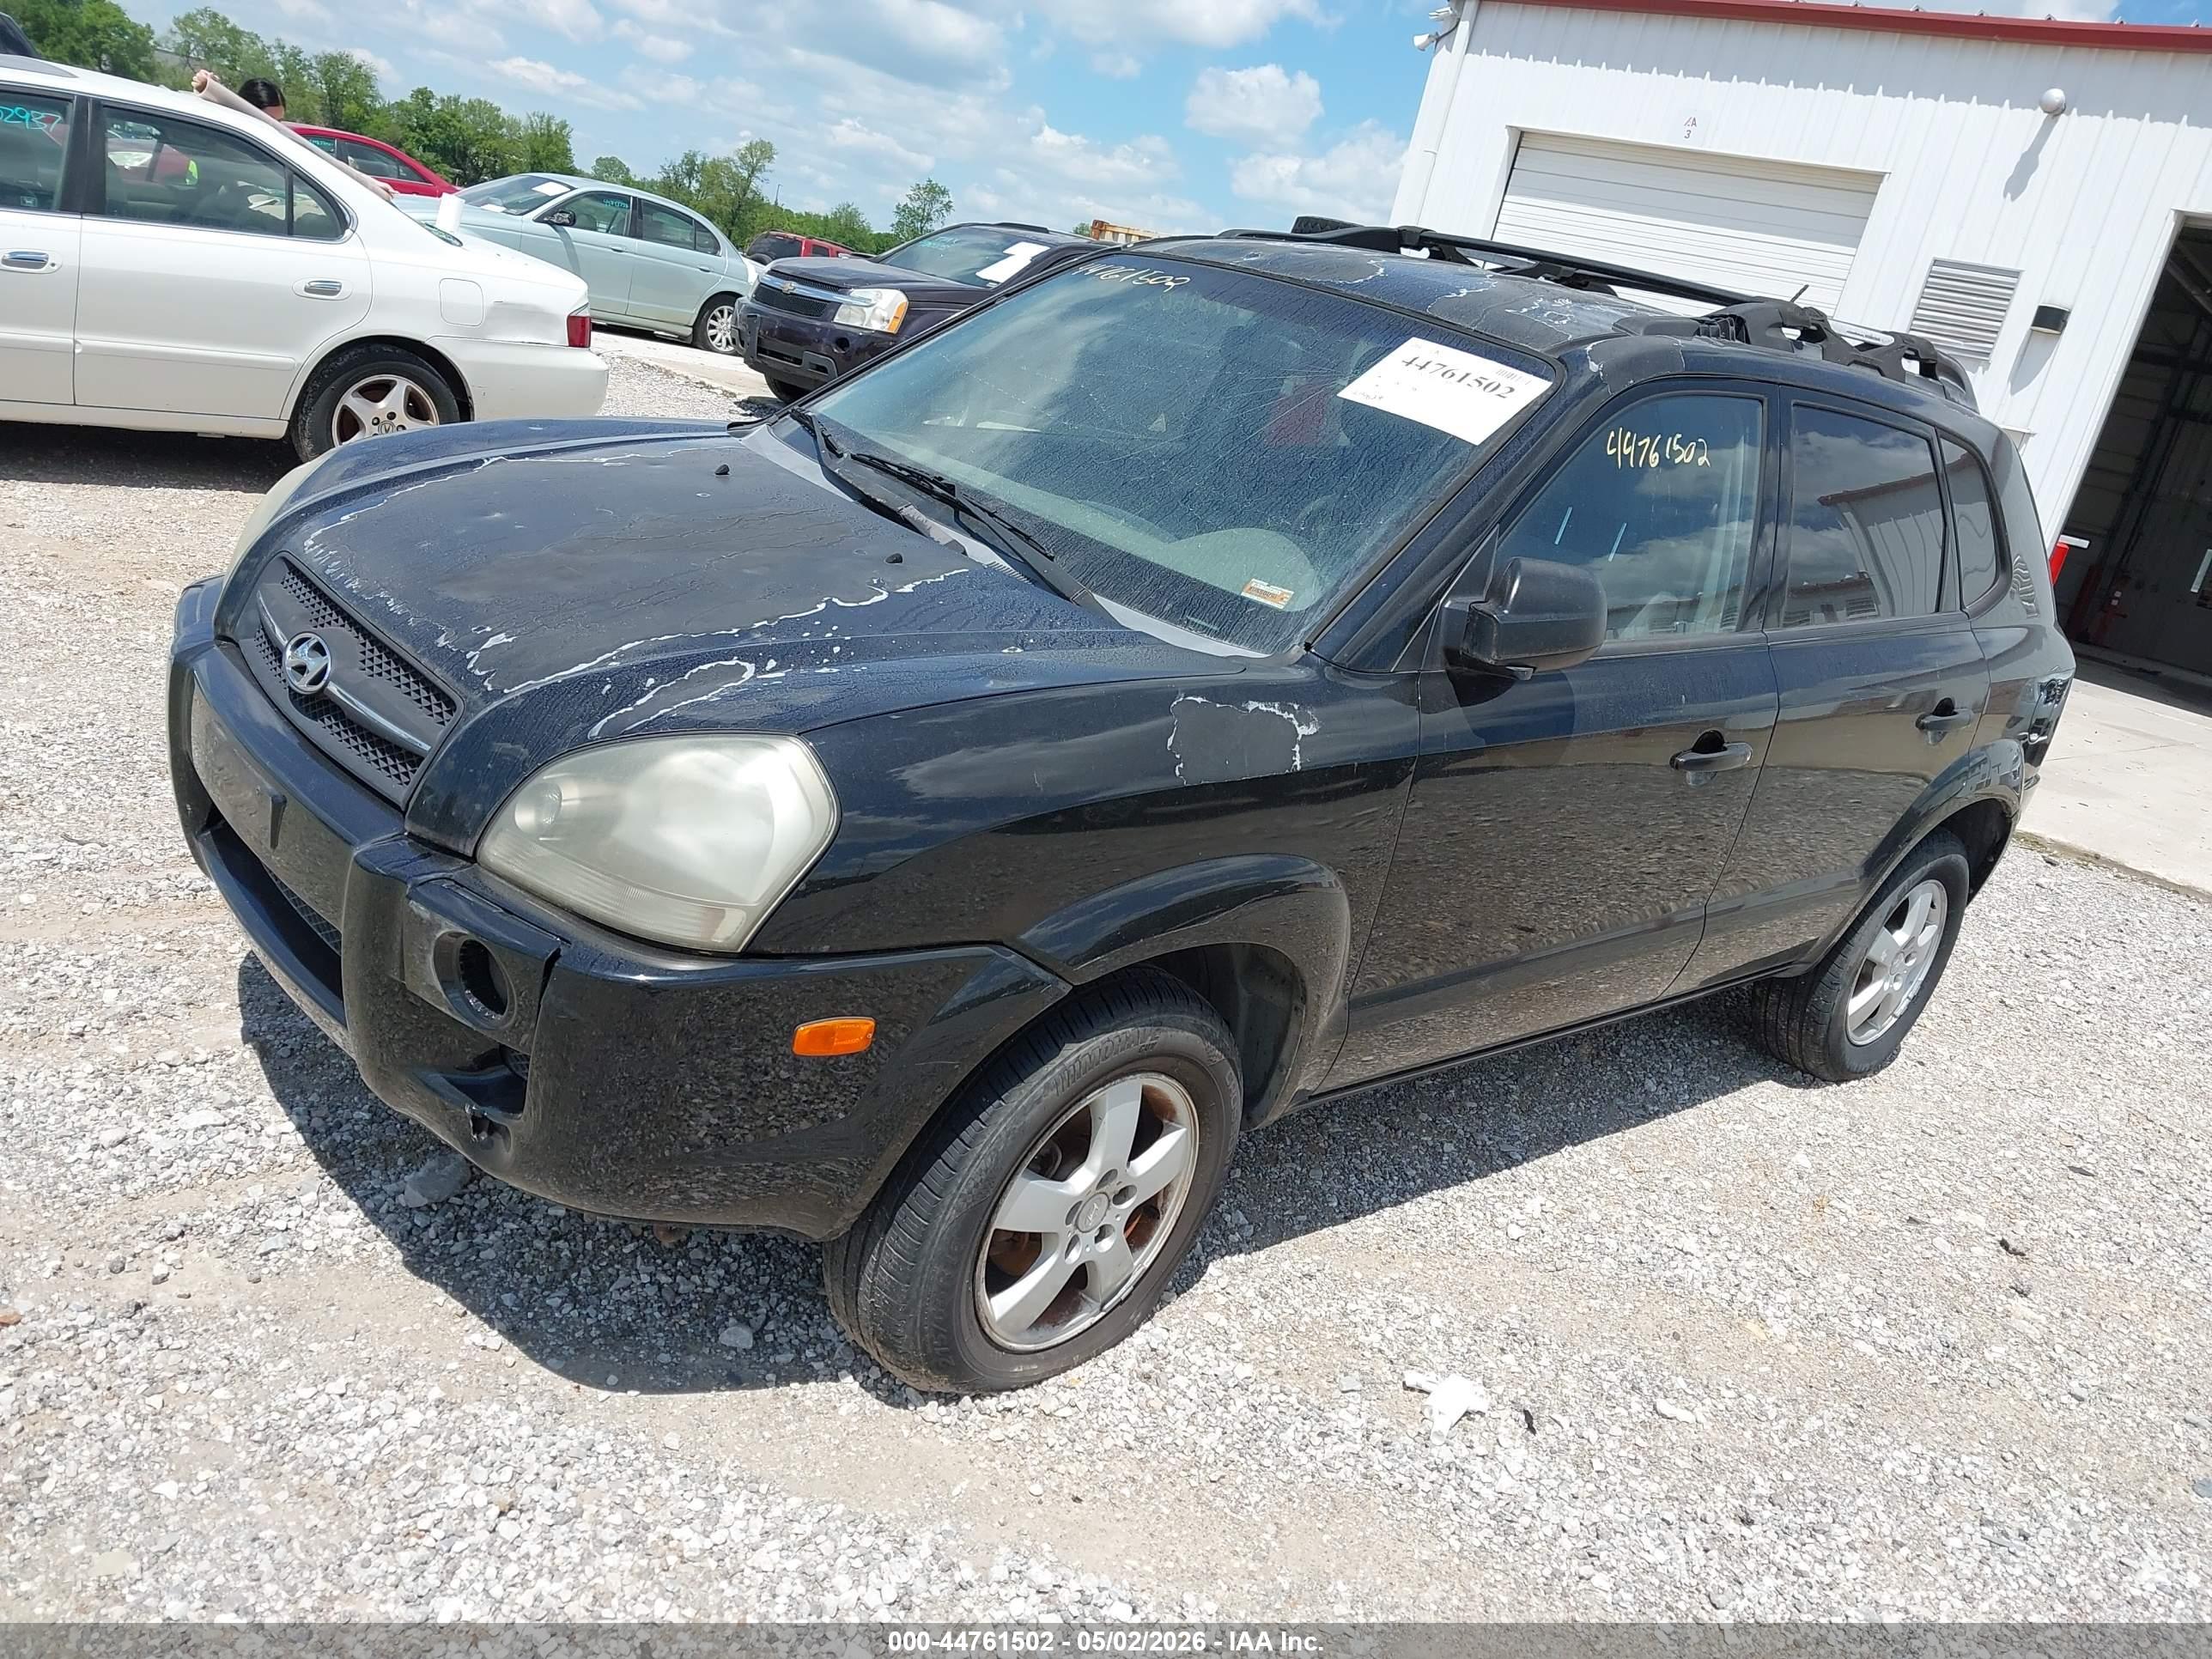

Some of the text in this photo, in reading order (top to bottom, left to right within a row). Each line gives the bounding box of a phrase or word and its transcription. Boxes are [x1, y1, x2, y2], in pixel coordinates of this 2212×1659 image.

[1684, 129, 1692, 139] 3
[1401, 356, 1516, 399] 44761502
[1607, 427, 1711, 469] 44761502
